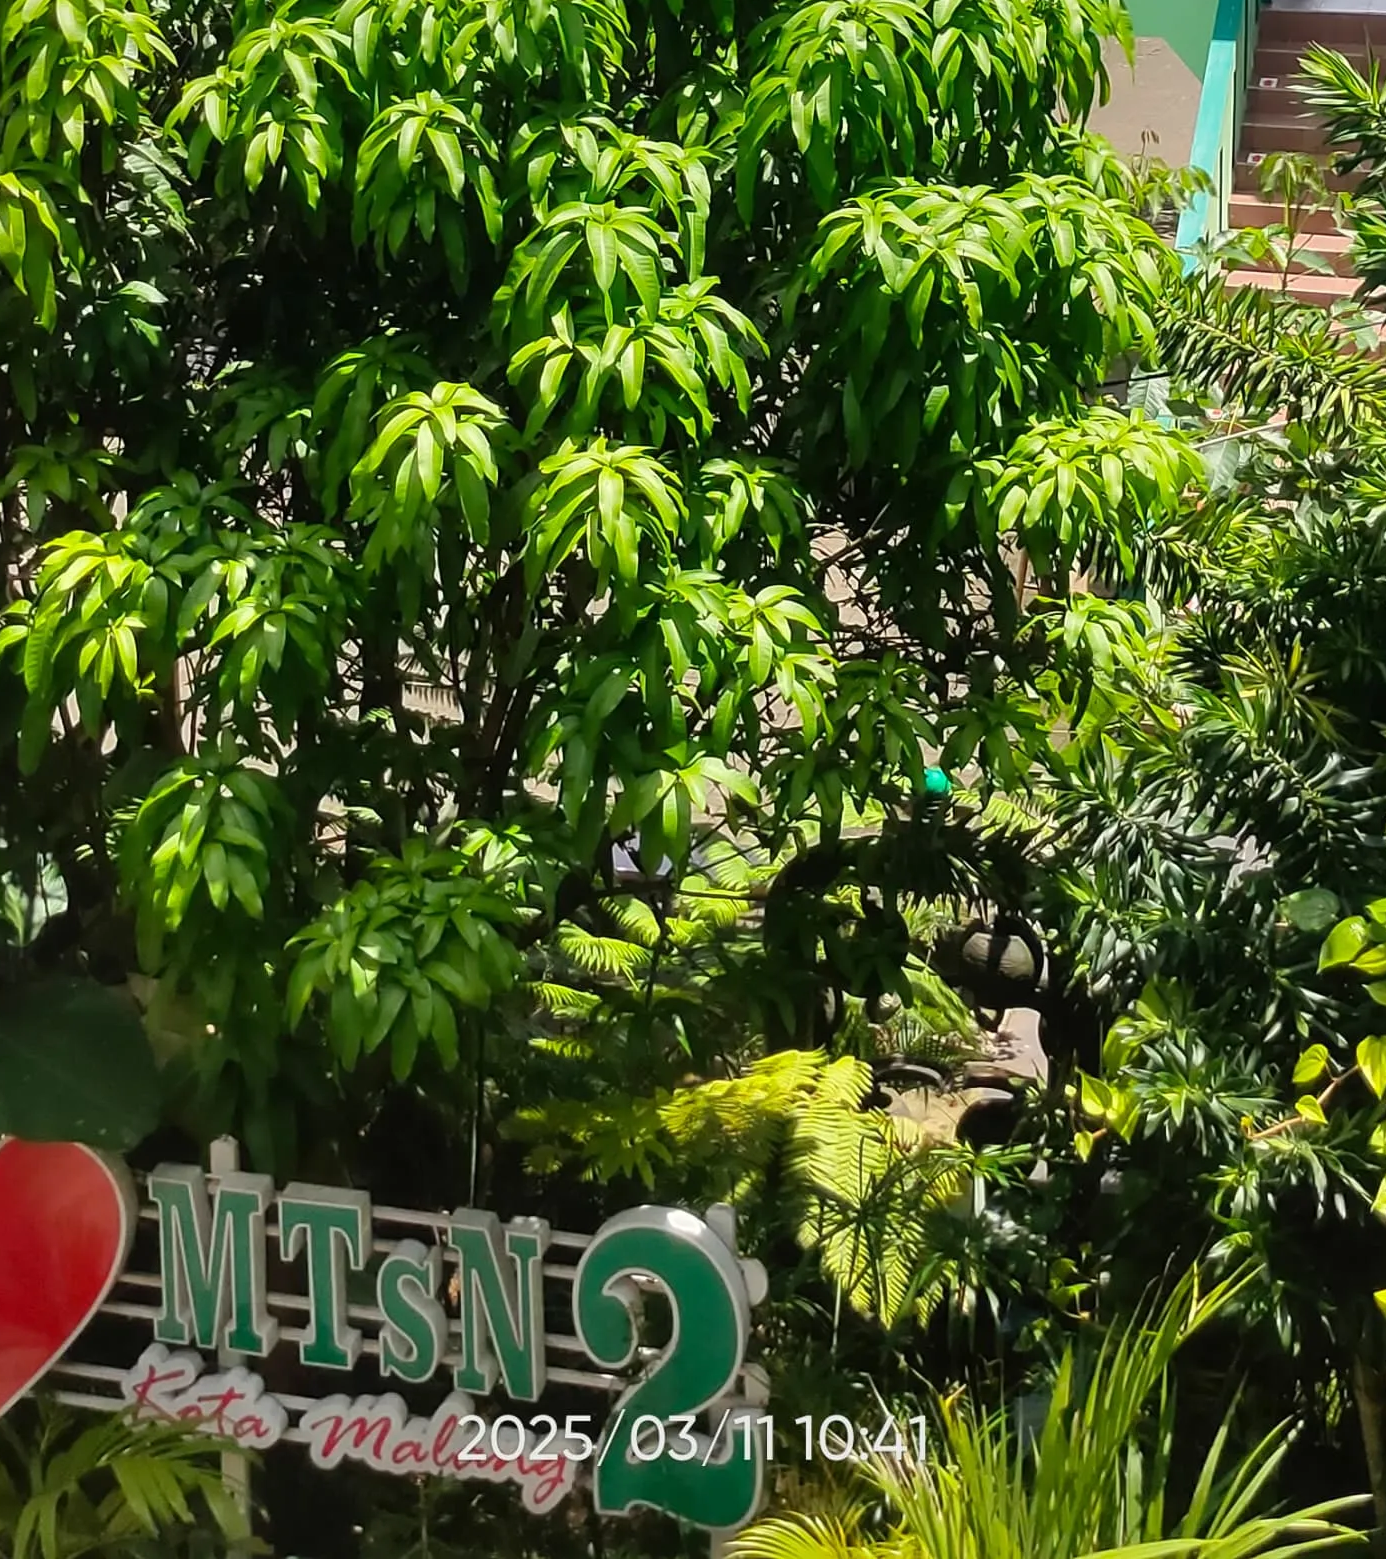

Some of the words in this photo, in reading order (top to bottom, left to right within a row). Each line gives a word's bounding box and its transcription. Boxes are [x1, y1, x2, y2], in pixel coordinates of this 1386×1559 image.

[132, 1365, 270, 1439] Kota
[148, 1168, 545, 1402] MTsN
[573, 1210, 760, 1529] 2
